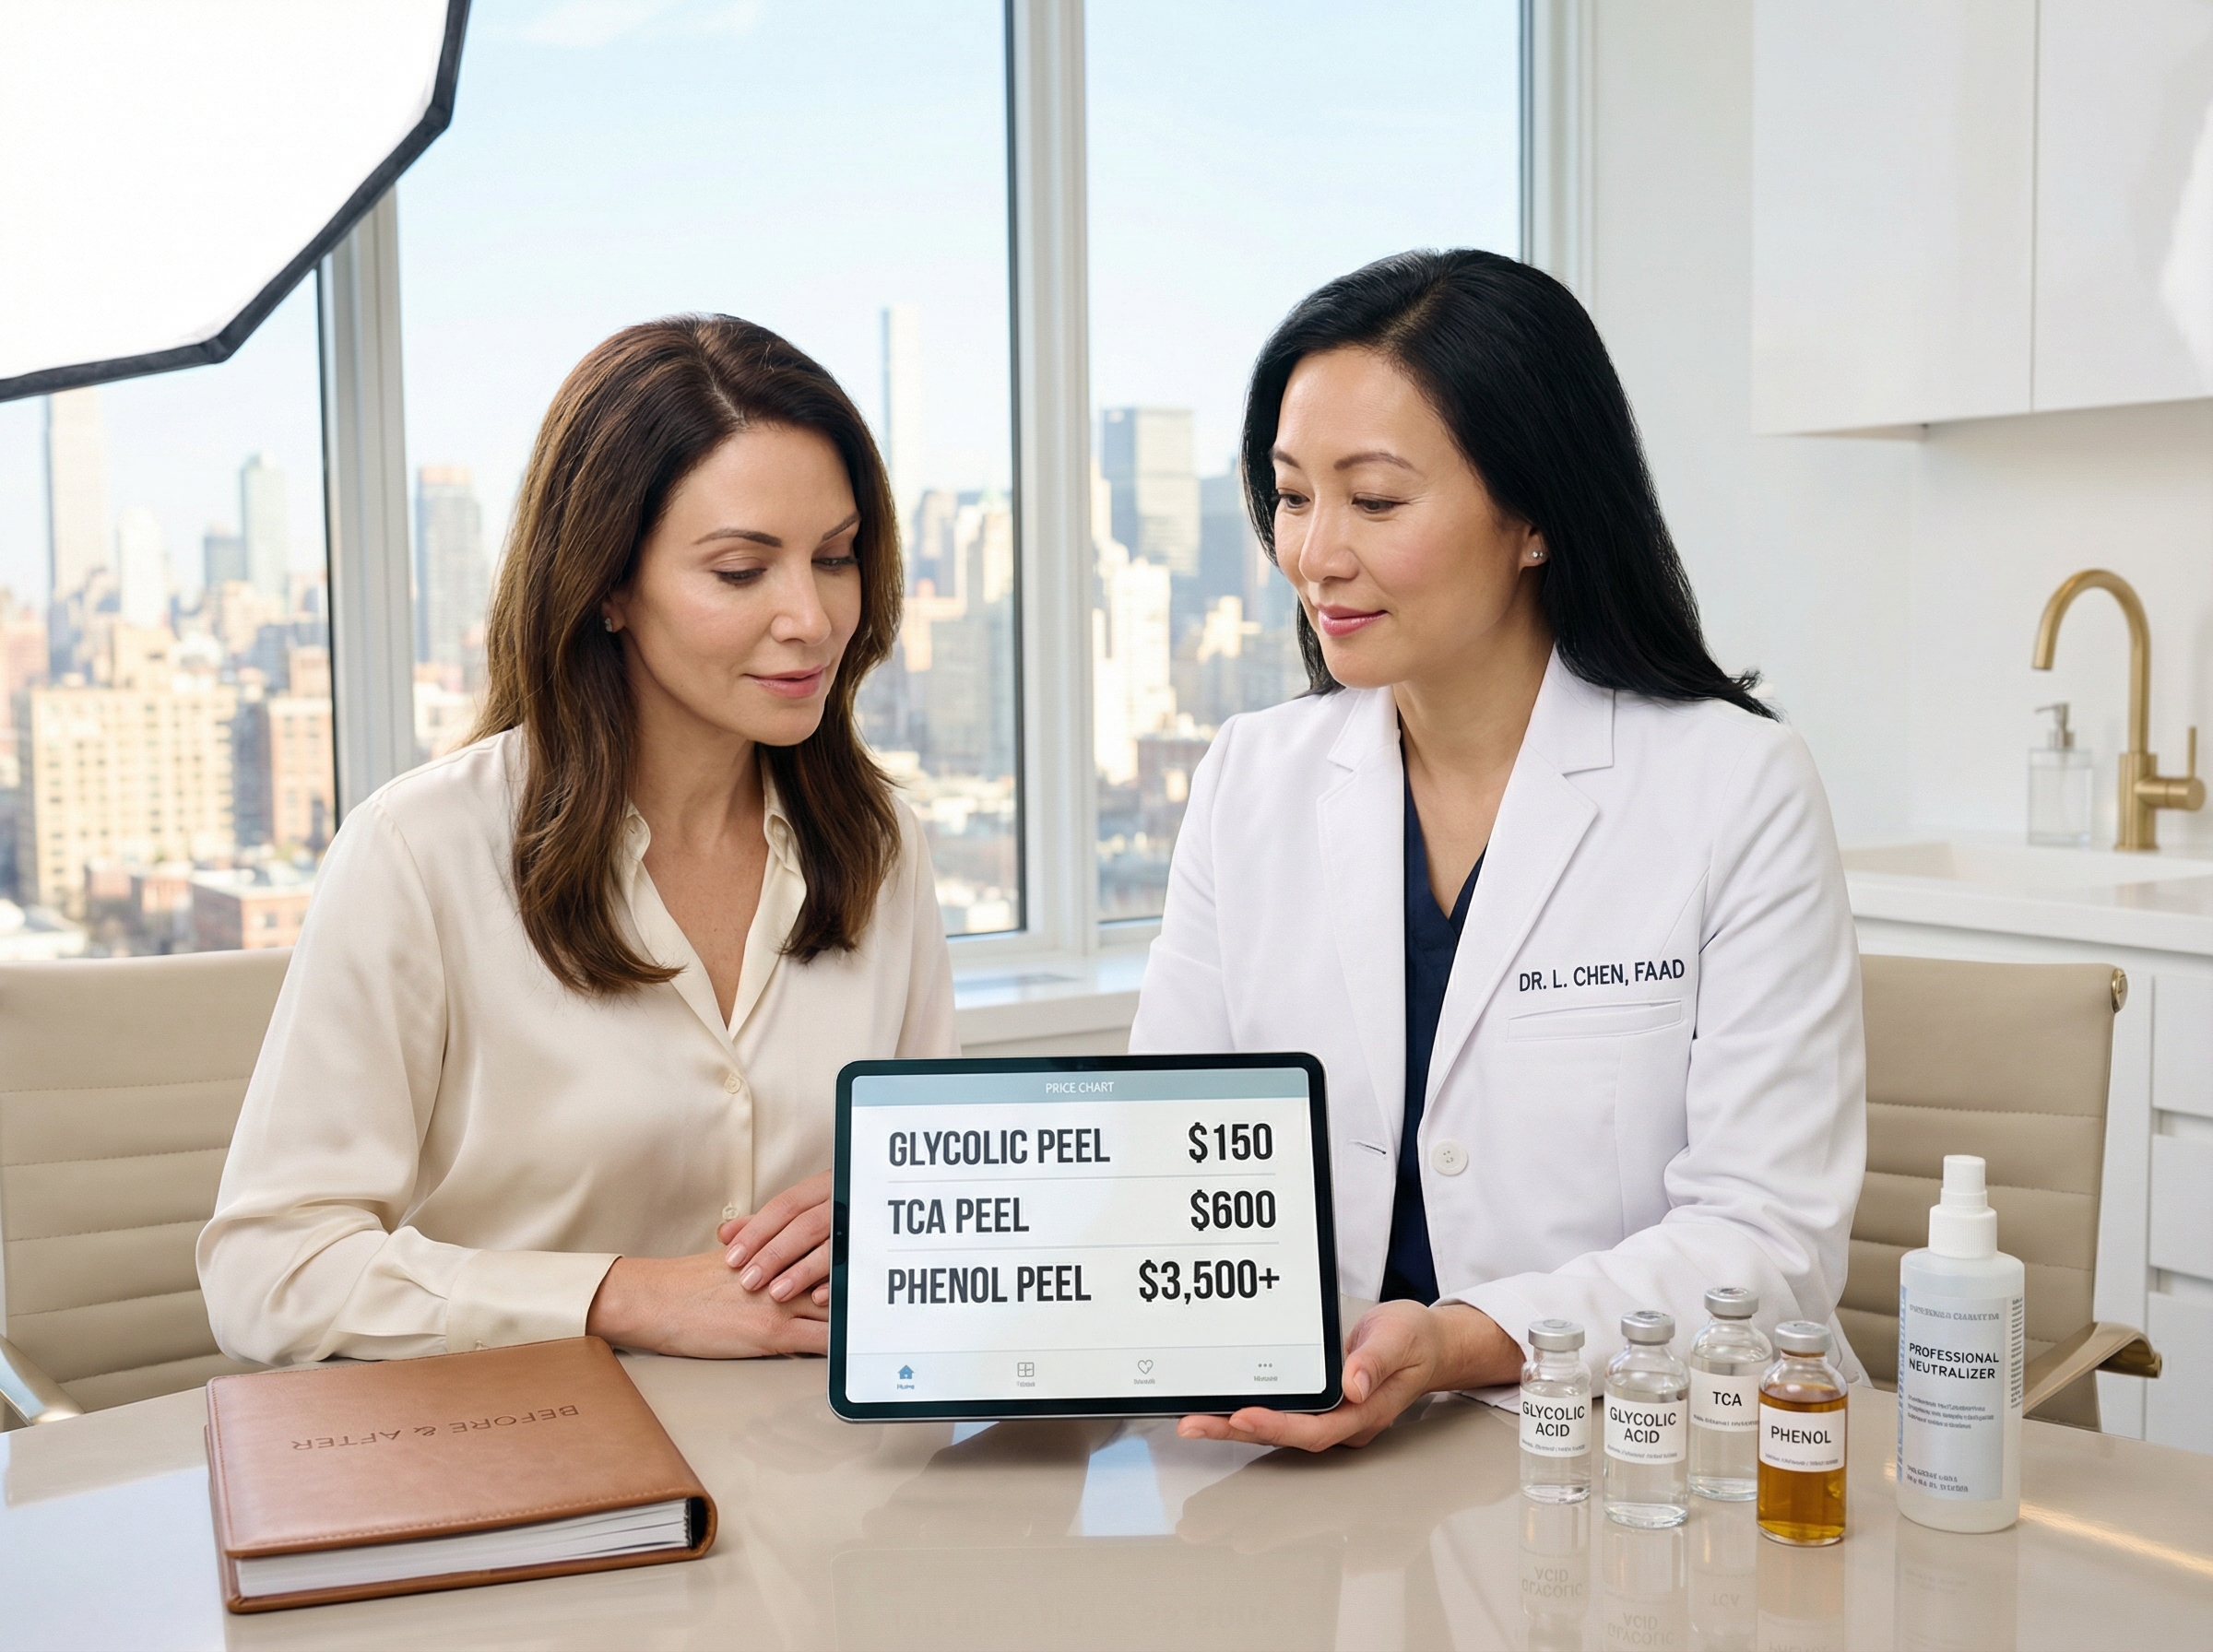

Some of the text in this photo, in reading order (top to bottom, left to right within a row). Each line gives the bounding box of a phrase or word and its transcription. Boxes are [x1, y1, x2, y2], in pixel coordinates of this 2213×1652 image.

[1520, 959, 1685, 992] DR. L. CHEN, FAAD
[1046, 1081, 1114, 1093] PRICE CHART
[888, 1127, 1110, 1167] GLYCOLIC PEEL
[1188, 1122, 1273, 1163] $150
[888, 1198, 1029, 1235] TCA PEEL
[1190, 1189, 1276, 1232] $600
[888, 1265, 1092, 1304] PHENOL PEEL
[1139, 1259, 1280, 1305] $3,500+
[1909, 1342, 1999, 1363] PROFESSIONAL
[1909, 1358, 1995, 1379] NEUTRALIZER
[1712, 1391, 1742, 1407] TCA
[1522, 1401, 1585, 1421] GLYCOLIC
[1610, 1407, 1676, 1427] GLYCOLIC
[292, 1405, 579, 1450] BEFORE & AFTER
[1535, 1422, 1570, 1437] ACID
[1624, 1428, 1660, 1444] ACID
[1770, 1425, 1831, 1445] PHENOL
